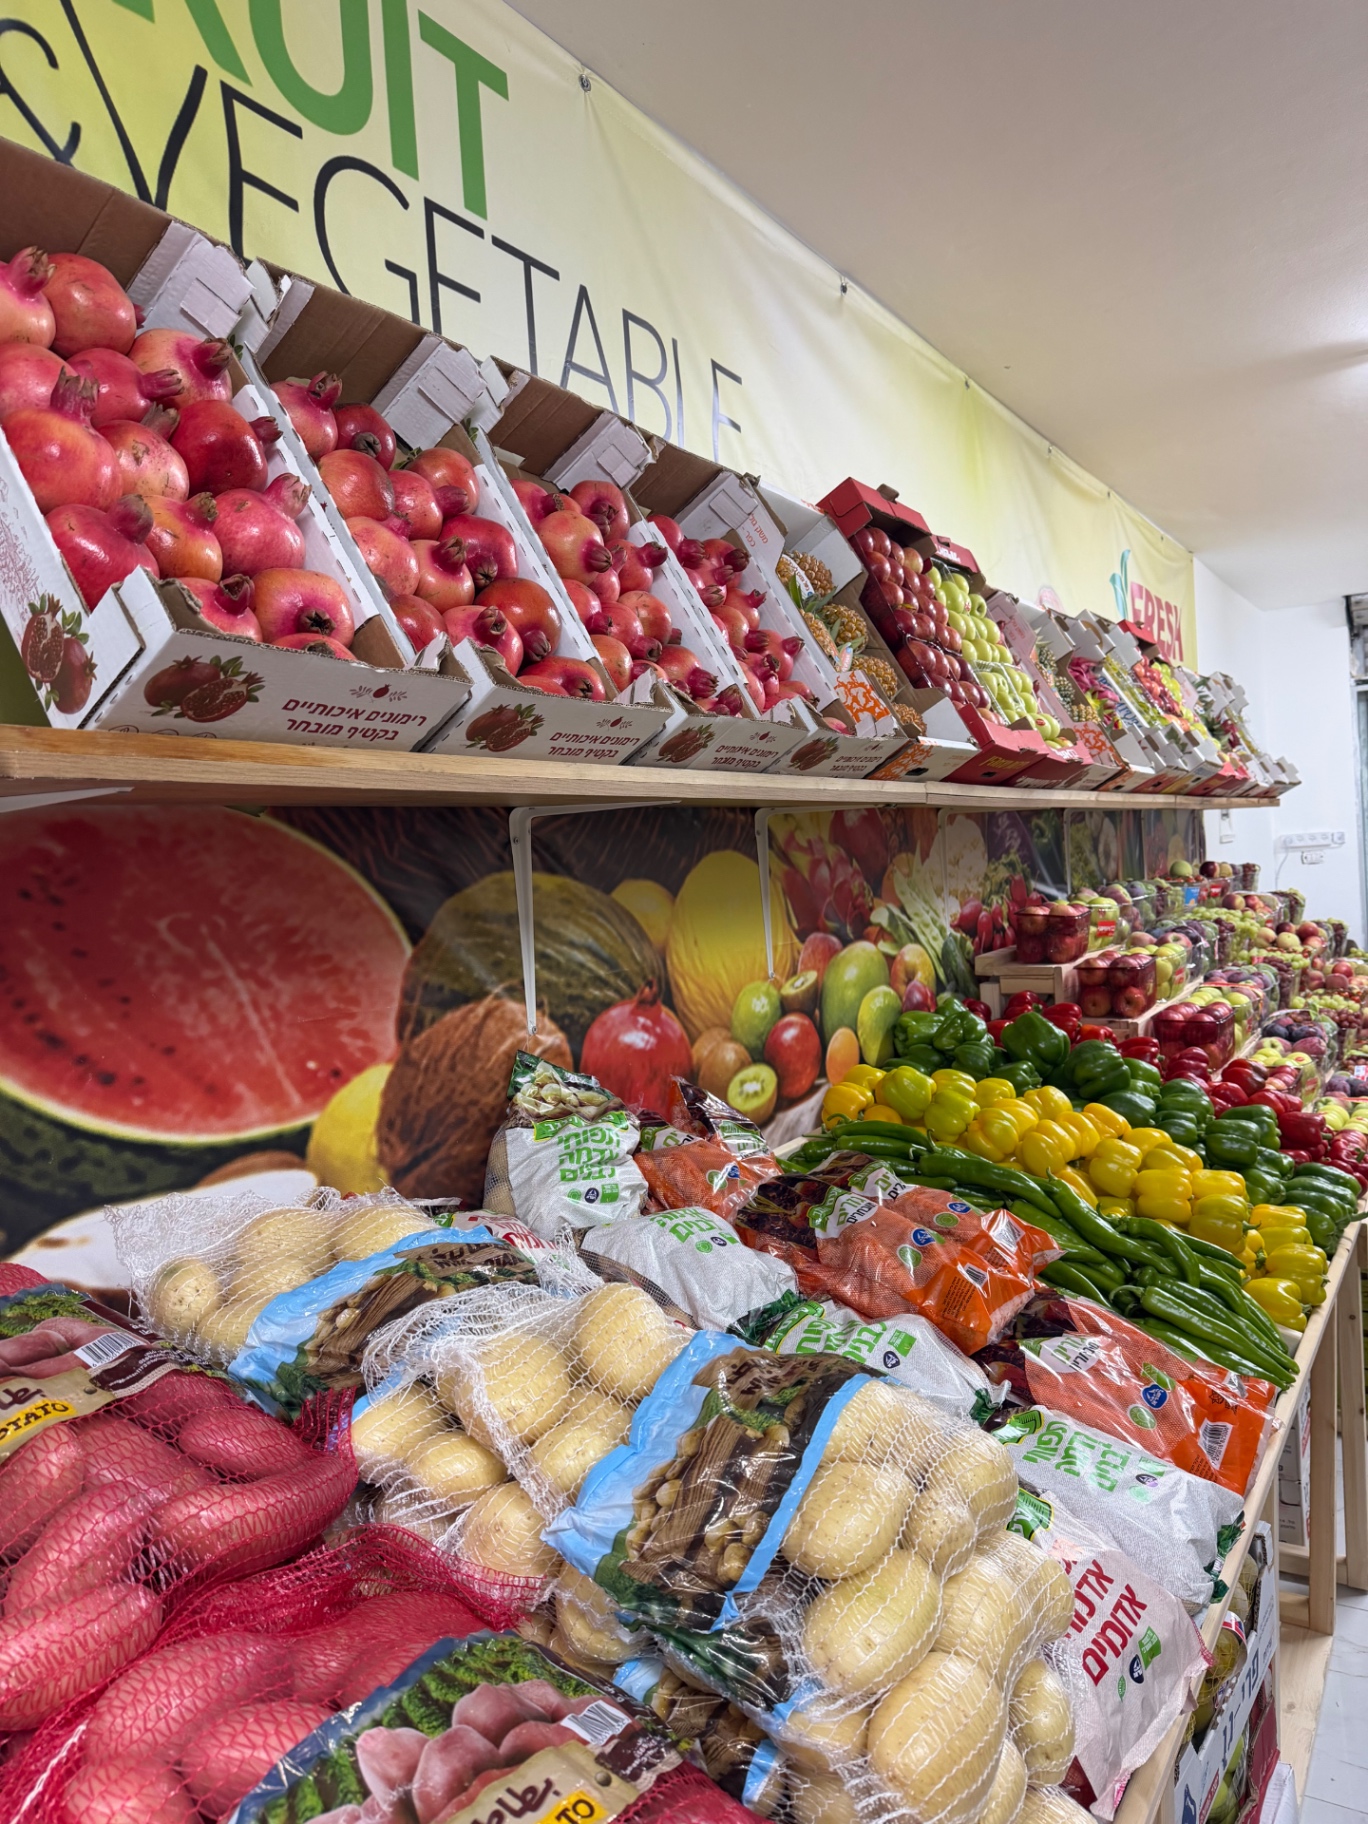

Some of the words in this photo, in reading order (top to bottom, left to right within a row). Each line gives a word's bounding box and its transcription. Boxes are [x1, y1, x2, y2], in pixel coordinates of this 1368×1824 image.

[1131, 581, 1184, 663] FRESH
[281, 699, 366, 720] איכותיים
[286, 718, 344, 736] מובחר
[364, 710, 427, 727] רימונים
[347, 725, 399, 742] בקטיף
[549, 732, 603, 744] איכותיים
[600, 736, 641, 747] רימונים
[548, 746, 585, 757] מובחר
[584, 748, 619, 760] בקטיף
[556, 1126, 620, 1151] תפוחי
[1022, 1420, 1070, 1464] תפוחי
[1082, 1584, 1148, 1688] אדומים
